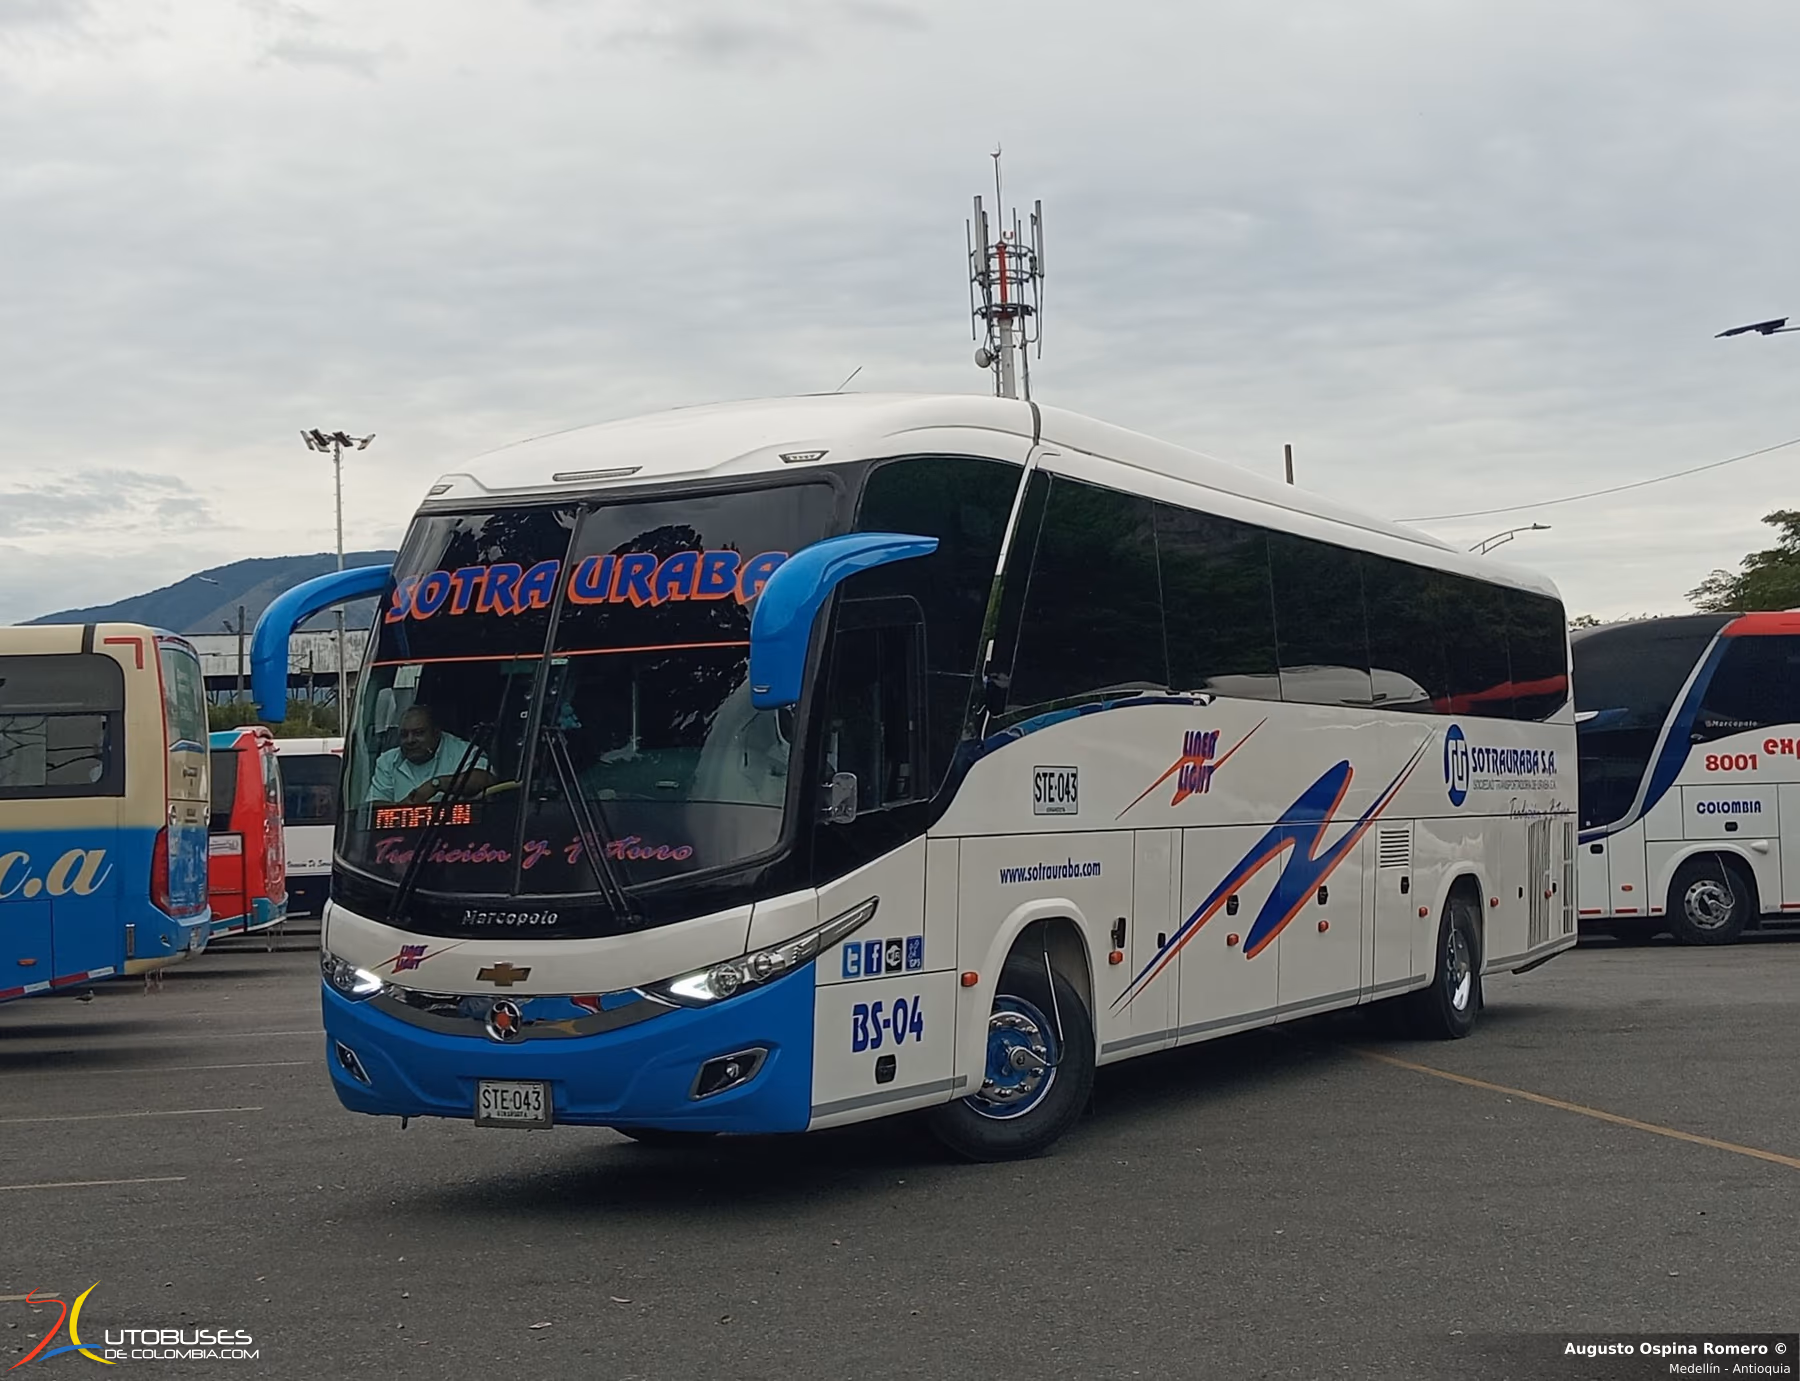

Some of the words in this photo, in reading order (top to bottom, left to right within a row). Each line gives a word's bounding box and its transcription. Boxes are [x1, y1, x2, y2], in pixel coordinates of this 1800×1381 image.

[385, 560, 560, 624] SOTRA
[568, 551, 789, 608] URABA
[1471, 747, 1539, 776] SOTRAURABA
[1541, 750, 1557, 776] S.A.
[1705, 754, 1758, 772] 8001
[1696, 800, 1762, 814] COLOMBIA
[1000, 857, 1101, 884] www.sotrauraba.com
[461, 910, 558, 926] Marcopolo
[852, 995, 923, 1052] BS-04
